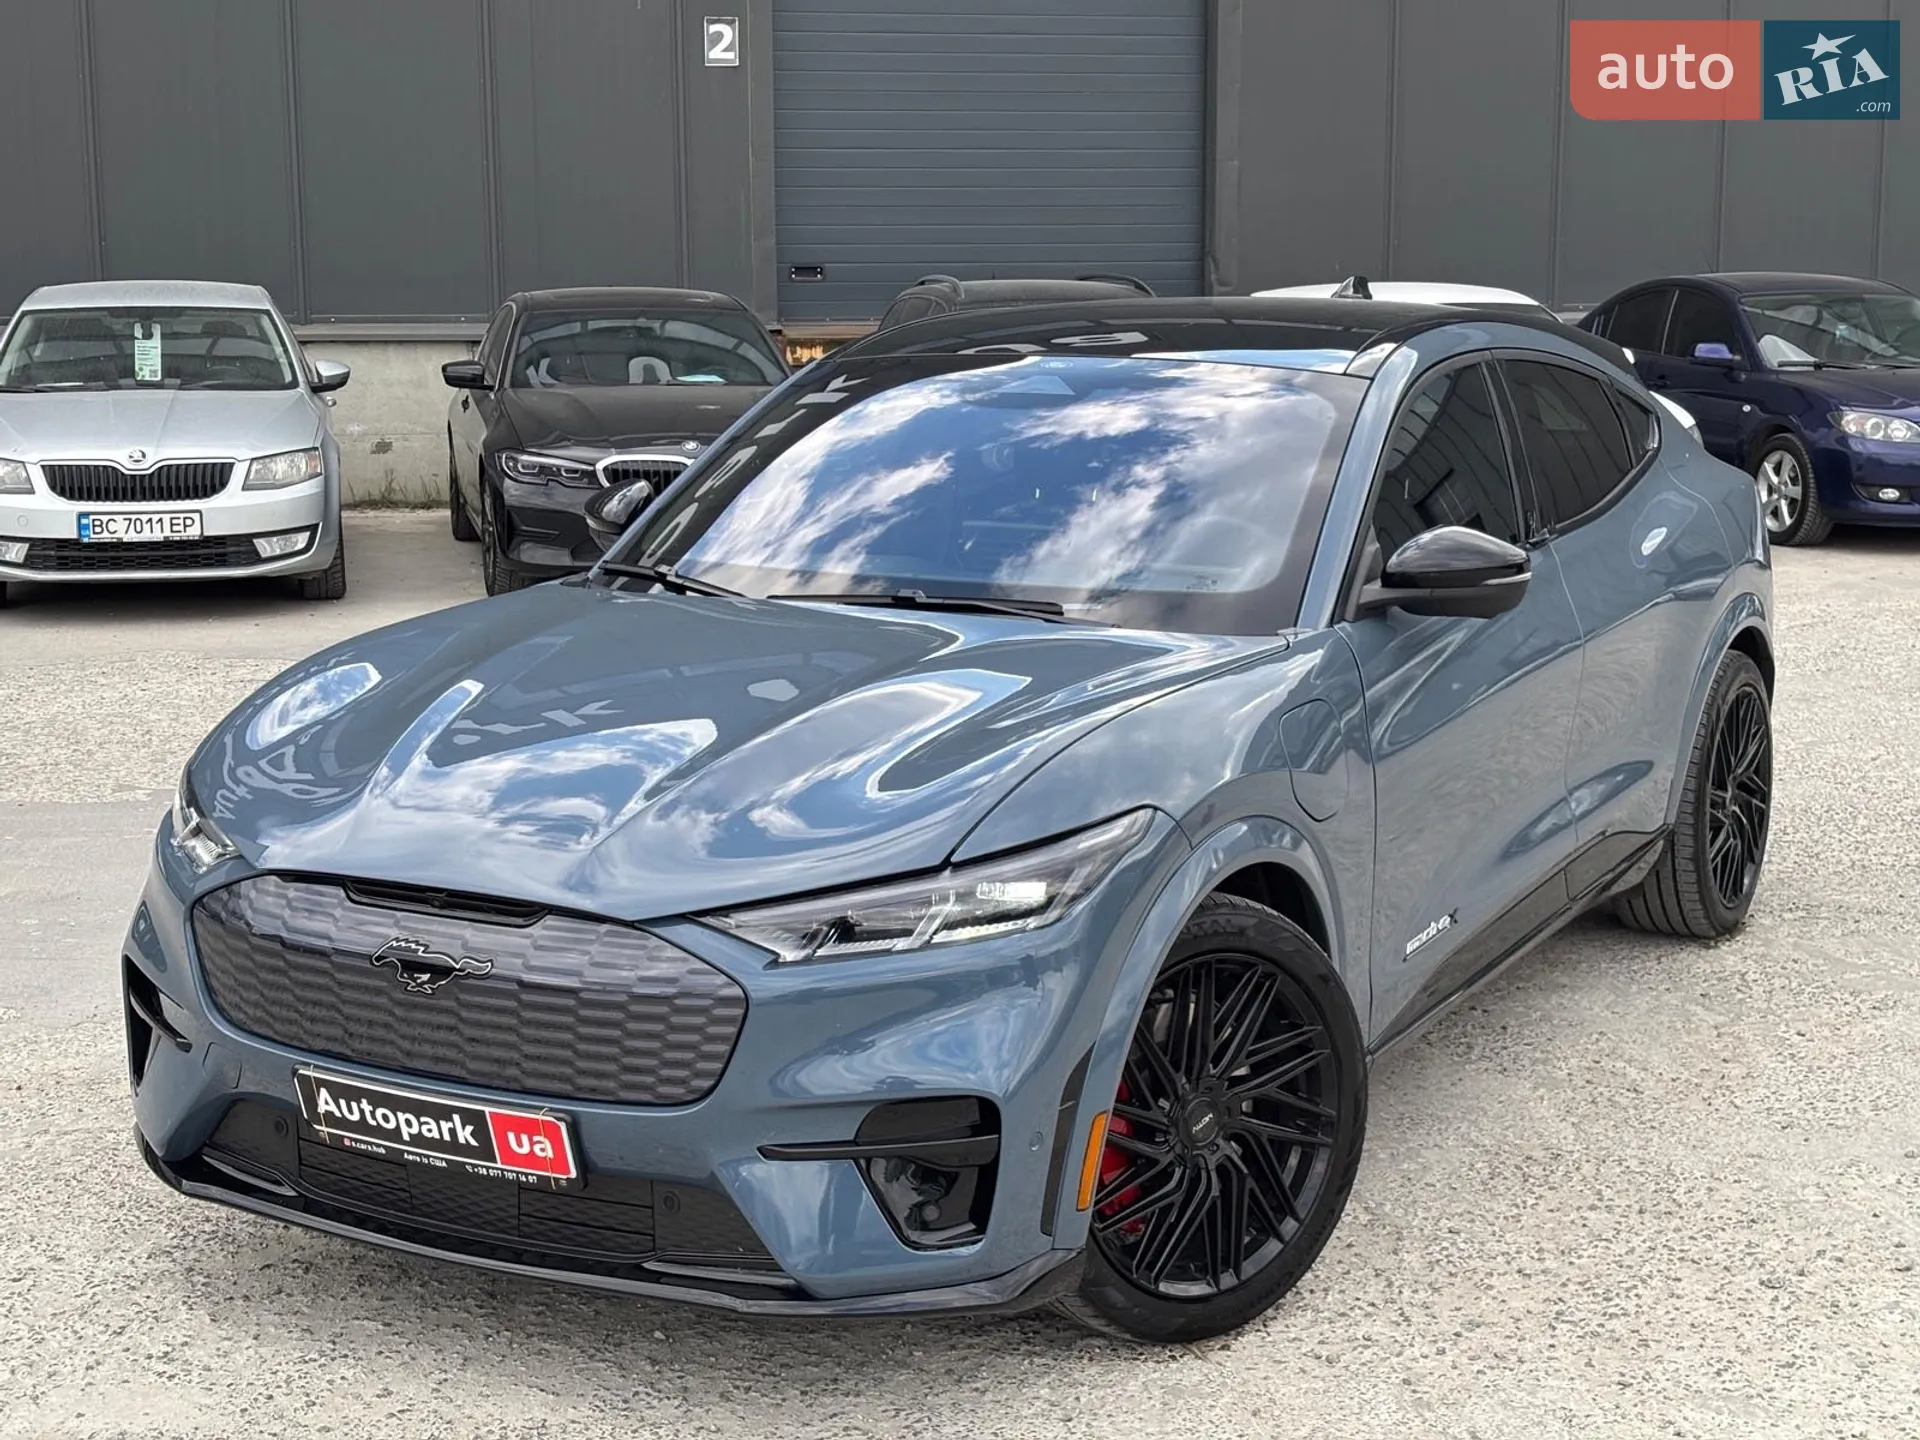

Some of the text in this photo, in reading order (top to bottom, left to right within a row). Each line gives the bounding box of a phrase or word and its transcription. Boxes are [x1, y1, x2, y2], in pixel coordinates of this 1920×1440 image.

[708, 23, 736, 60] 2
[92, 516, 195, 535] BC 7011 EP
[317, 1086, 555, 1160] Autopark ua
